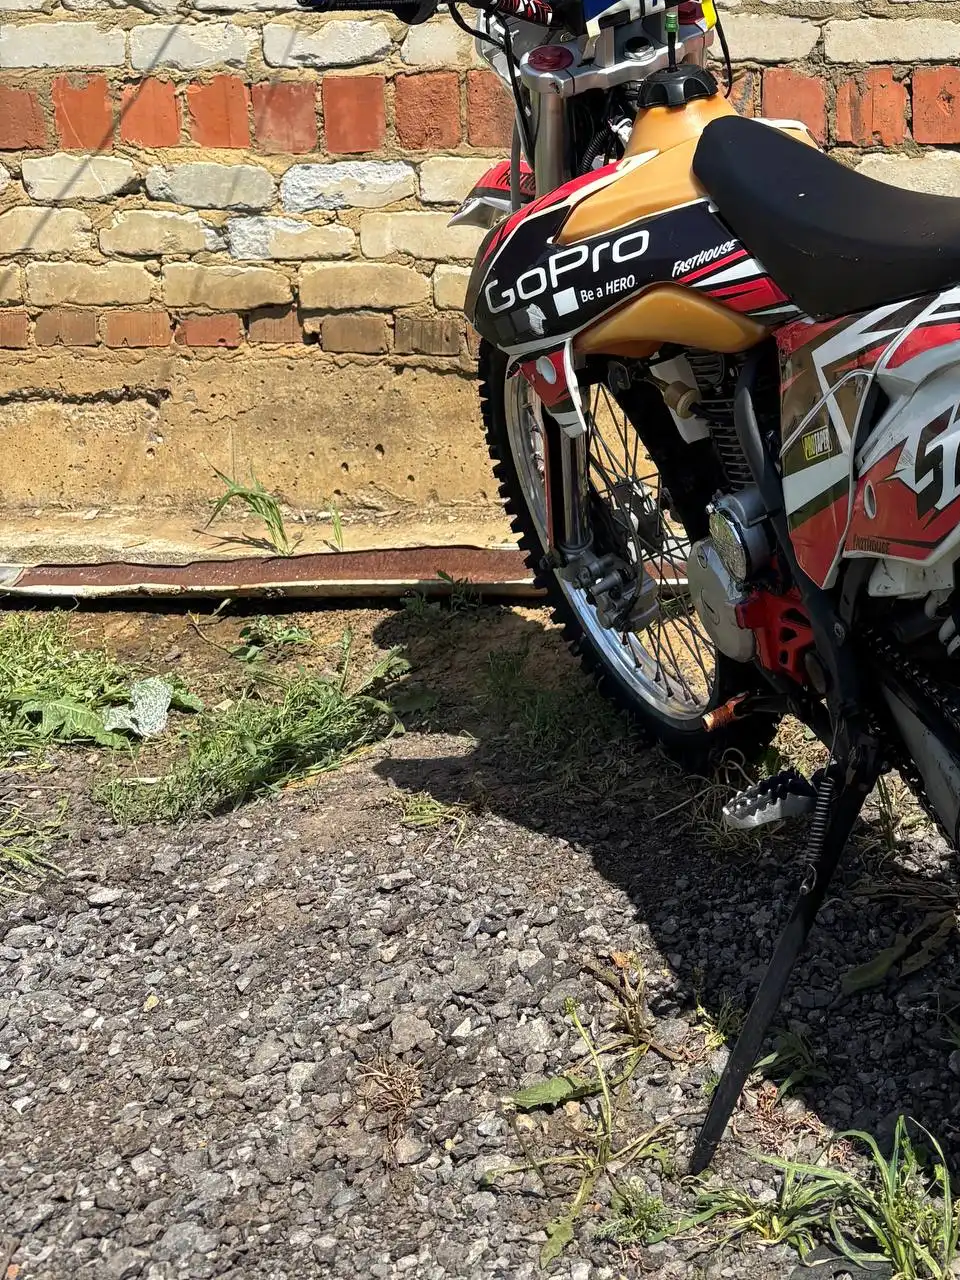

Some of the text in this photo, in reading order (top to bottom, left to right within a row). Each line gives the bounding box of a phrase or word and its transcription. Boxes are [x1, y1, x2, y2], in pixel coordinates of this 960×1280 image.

[484, 229, 650, 315] GoPro
[671, 238, 738, 278] FASTHOUSE
[580, 288, 596, 303] Be
[596, 287, 604, 298] a
